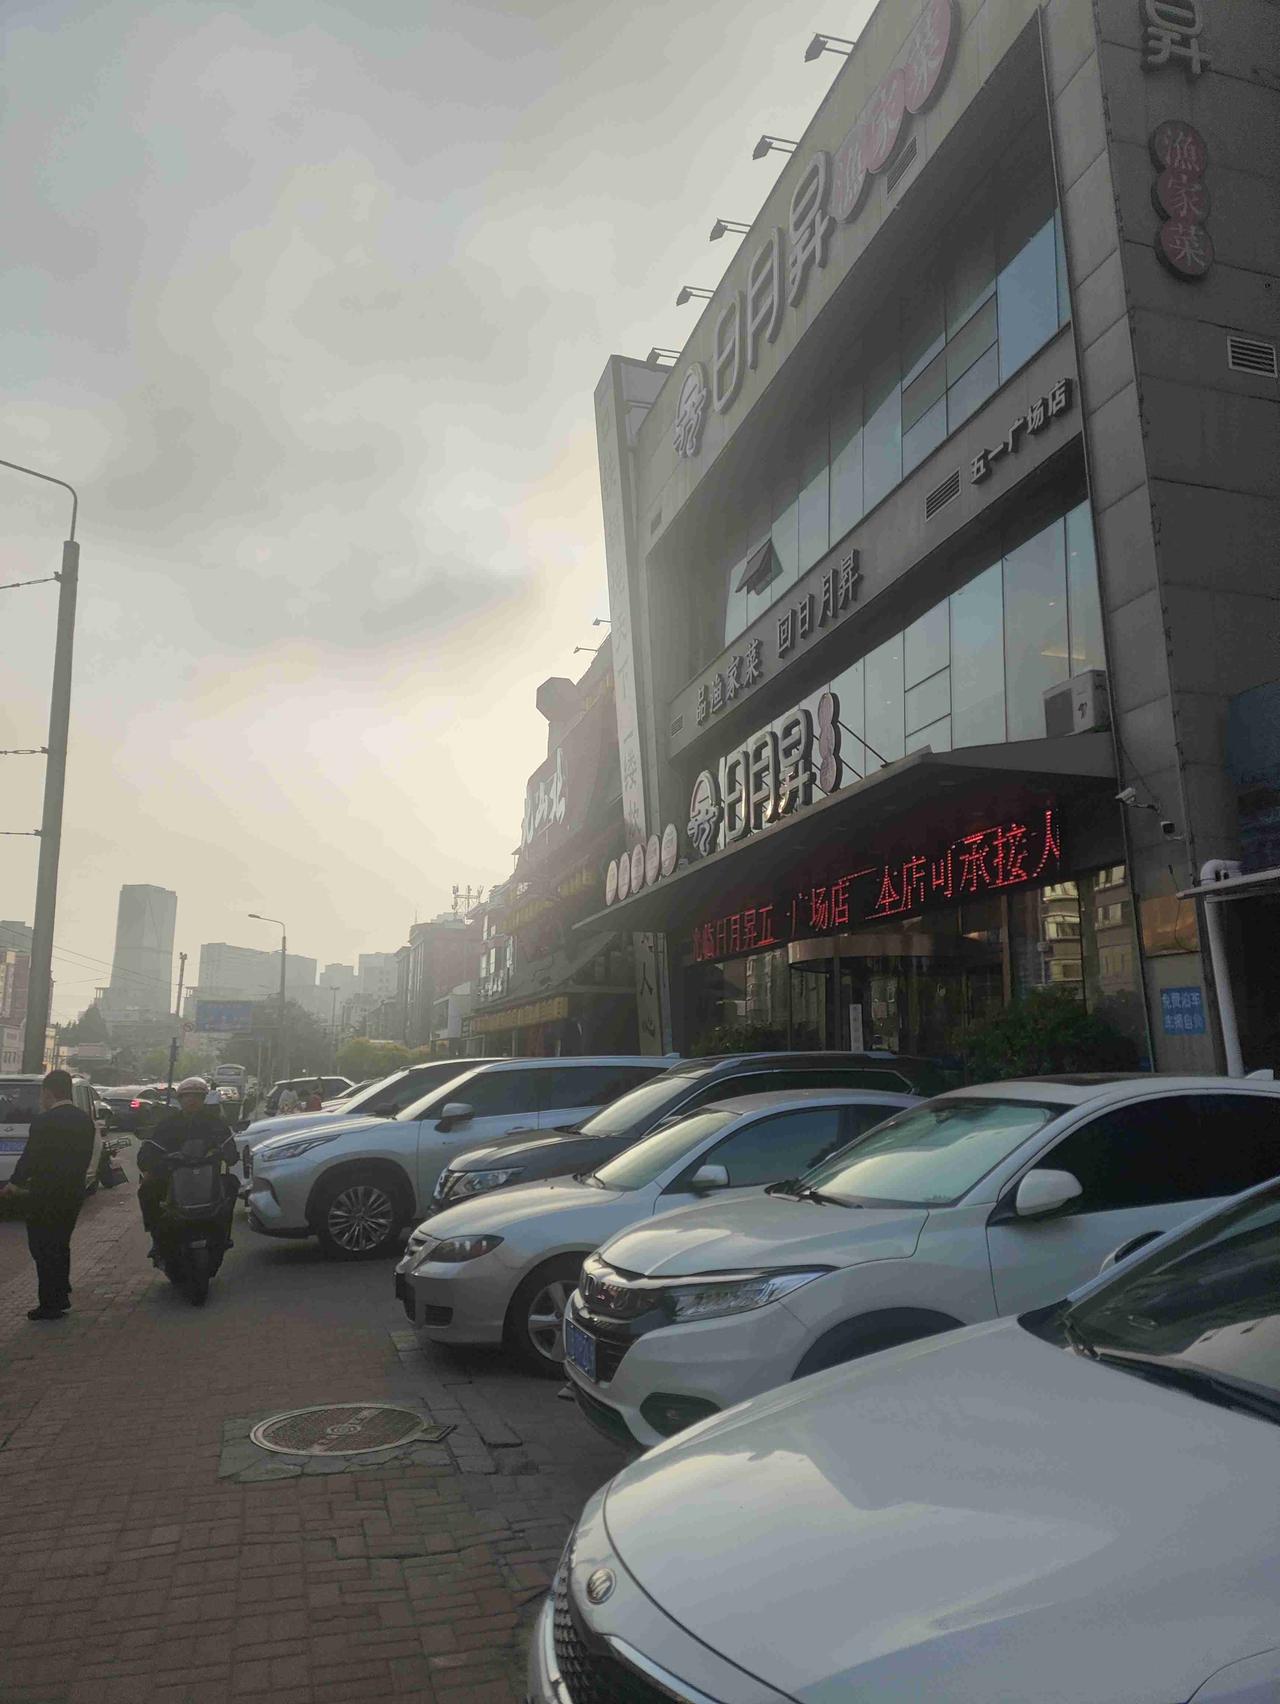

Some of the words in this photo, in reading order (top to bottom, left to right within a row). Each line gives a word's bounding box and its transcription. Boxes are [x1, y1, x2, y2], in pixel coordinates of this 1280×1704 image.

[970, 377, 1070, 483] 五一广场店
